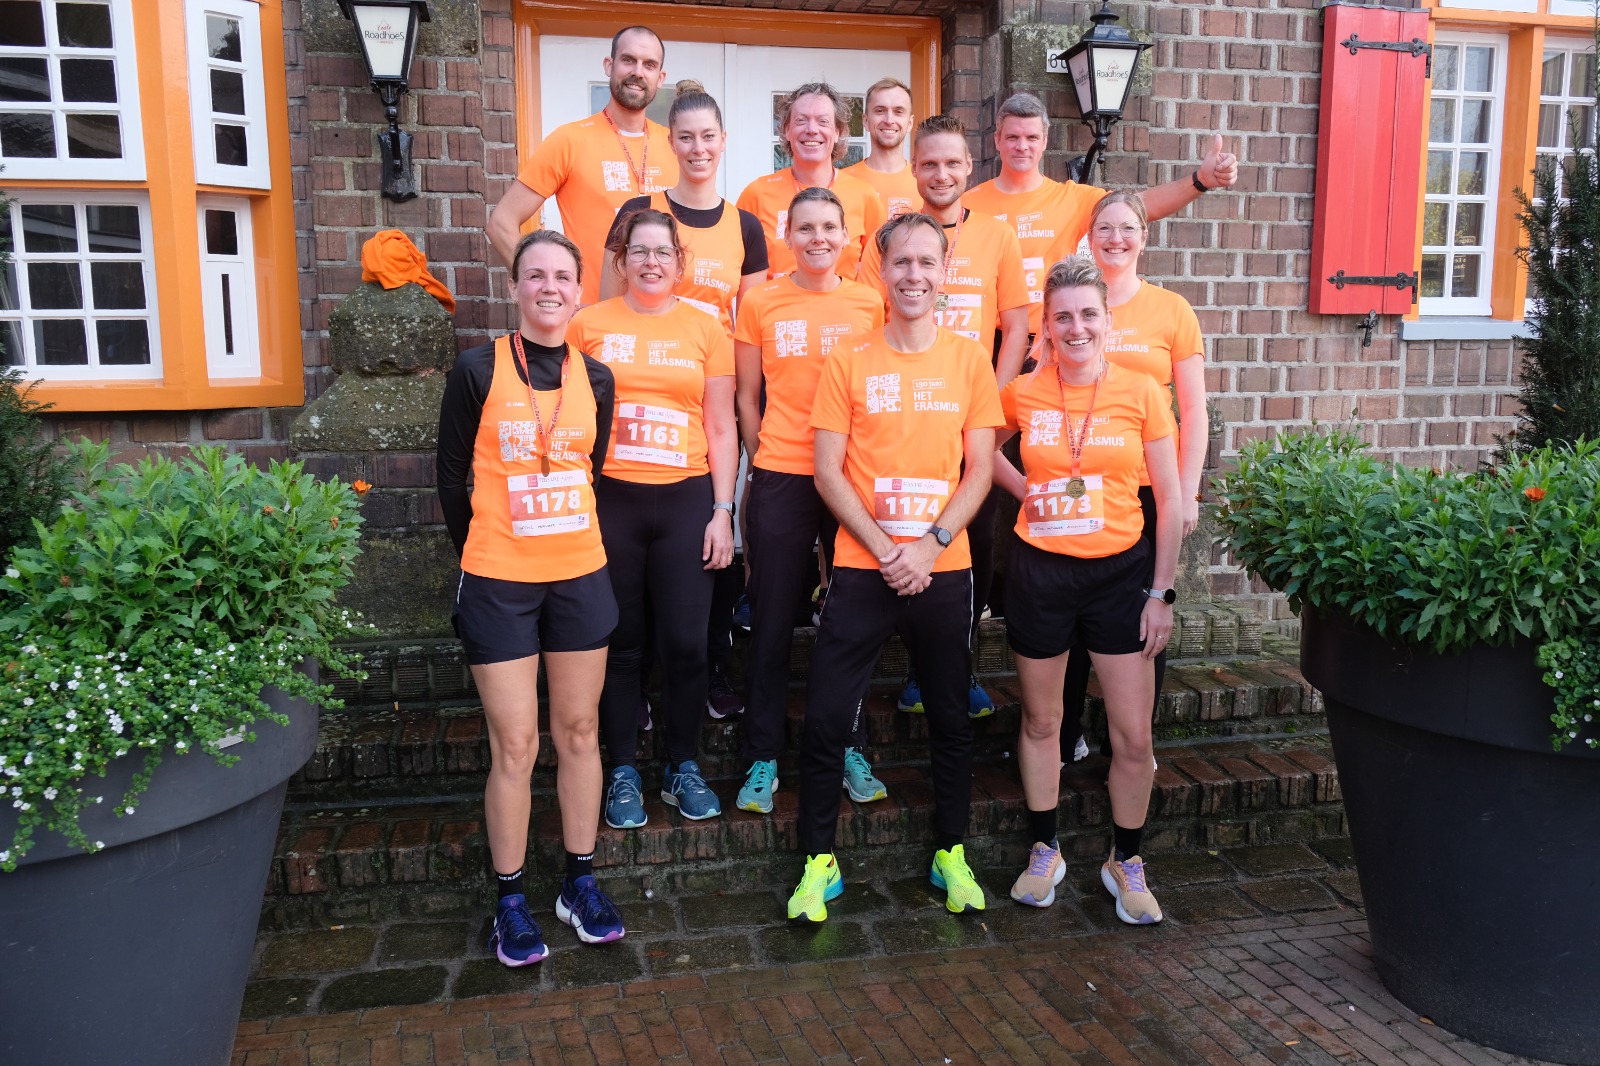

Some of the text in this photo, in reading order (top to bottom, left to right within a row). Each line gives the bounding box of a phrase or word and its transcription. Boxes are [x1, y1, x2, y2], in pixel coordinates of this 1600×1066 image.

[1018, 223, 1032, 231] HET
[1018, 230, 1054, 239] ERASMUS
[694, 268, 712, 277] HET
[948, 268, 958, 276] ET
[694, 277, 732, 293] ERASMUS
[946, 276, 982, 286] RASMUS
[934, 310, 973, 327] 177
[820, 336, 840, 346] HET
[1106, 337, 1124, 345] HET
[1105, 344, 1149, 353] ERASMUS
[649, 350, 667, 358] HET
[648, 358, 696, 369] ERASMUS
[915, 382, 928, 390] 150
[914, 392, 932, 401] HET
[914, 402, 960, 412] ERASMUS
[1092, 416, 1107, 426] jaar
[554, 430, 584, 438] 150 jaar
[628, 422, 680, 447] 1163
[1075, 428, 1094, 436] HT
[1076, 436, 1125, 446] ASMUS
[551, 442, 570, 450] HET
[521, 490, 581, 514] 1178
[885, 496, 940, 517] 1174
[1034, 496, 1092, 516] 1173
